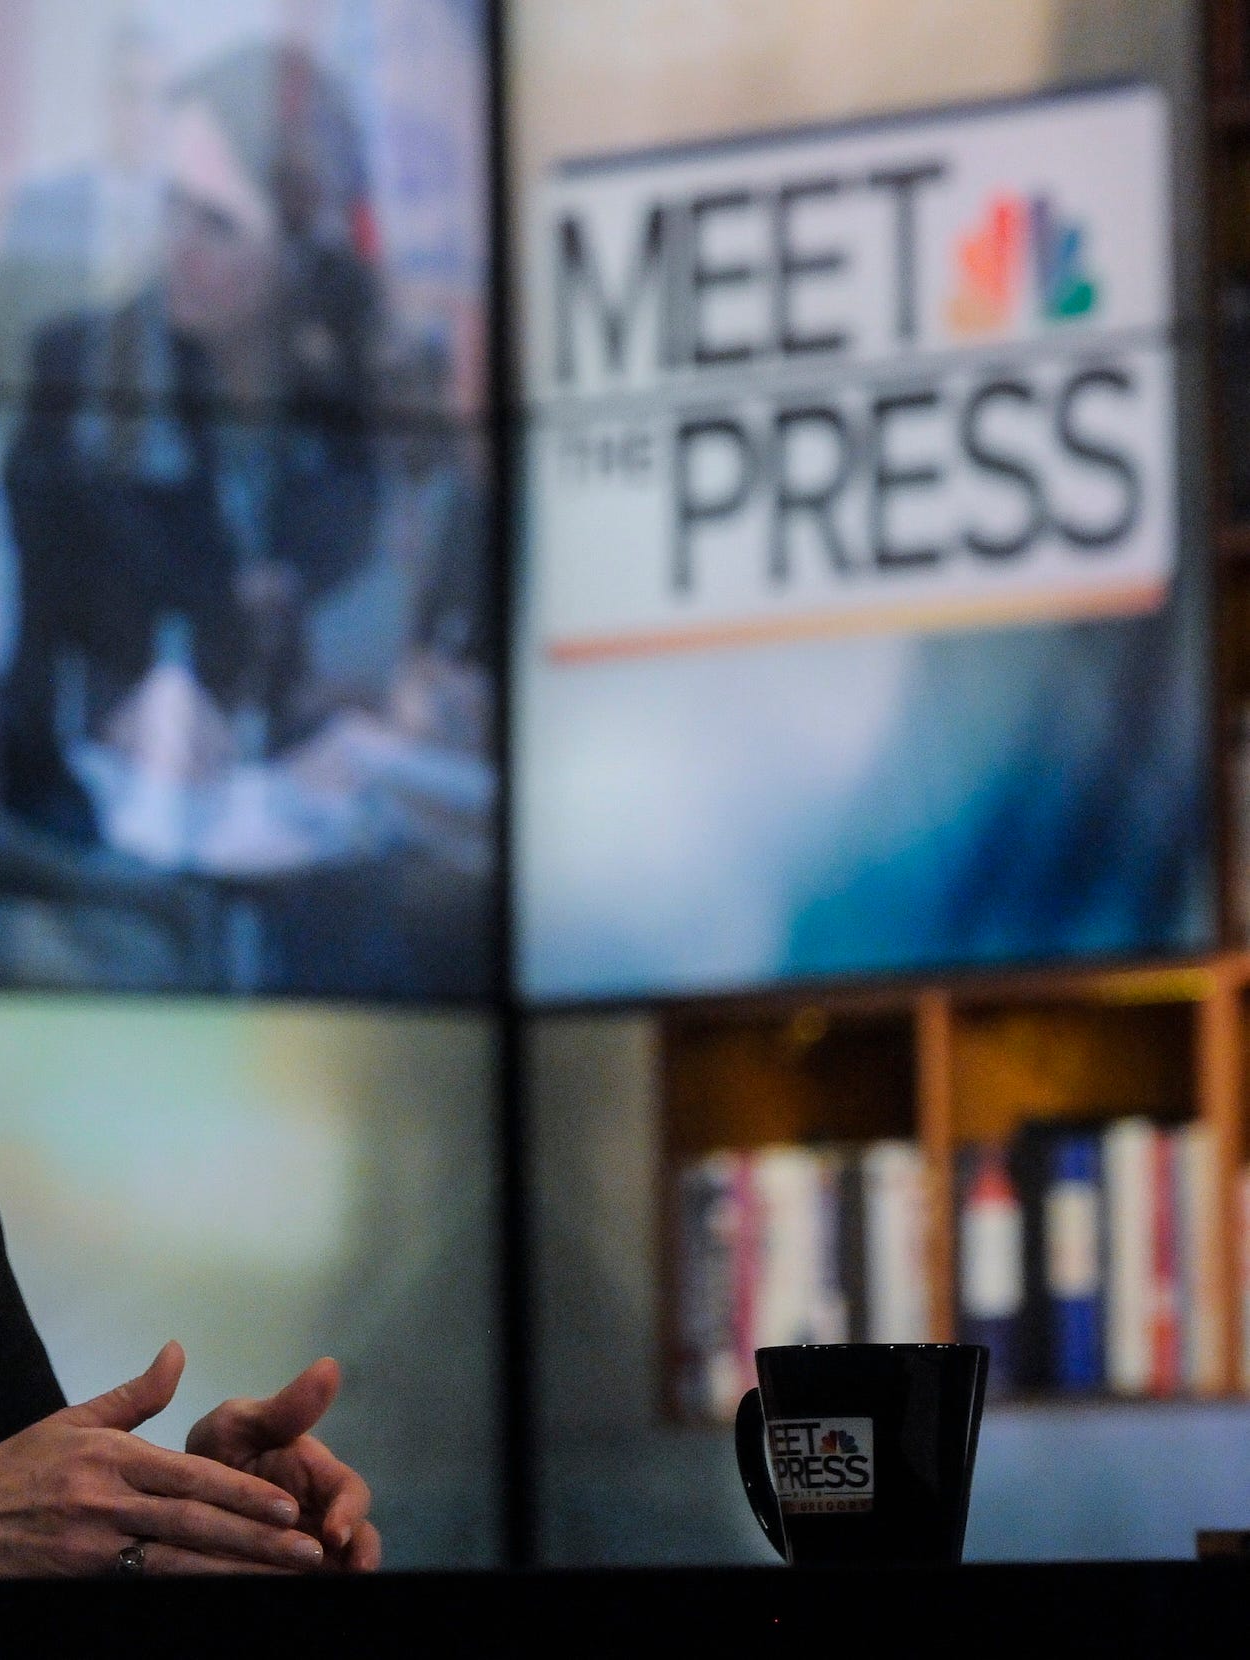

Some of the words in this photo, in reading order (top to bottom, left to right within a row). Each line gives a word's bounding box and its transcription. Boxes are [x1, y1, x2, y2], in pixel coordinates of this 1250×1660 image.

[554, 160, 948, 383] MEET
[671, 370, 1142, 595] PRESS
[768, 1422, 821, 1456] EET
[775, 1454, 870, 1490] PRESS
